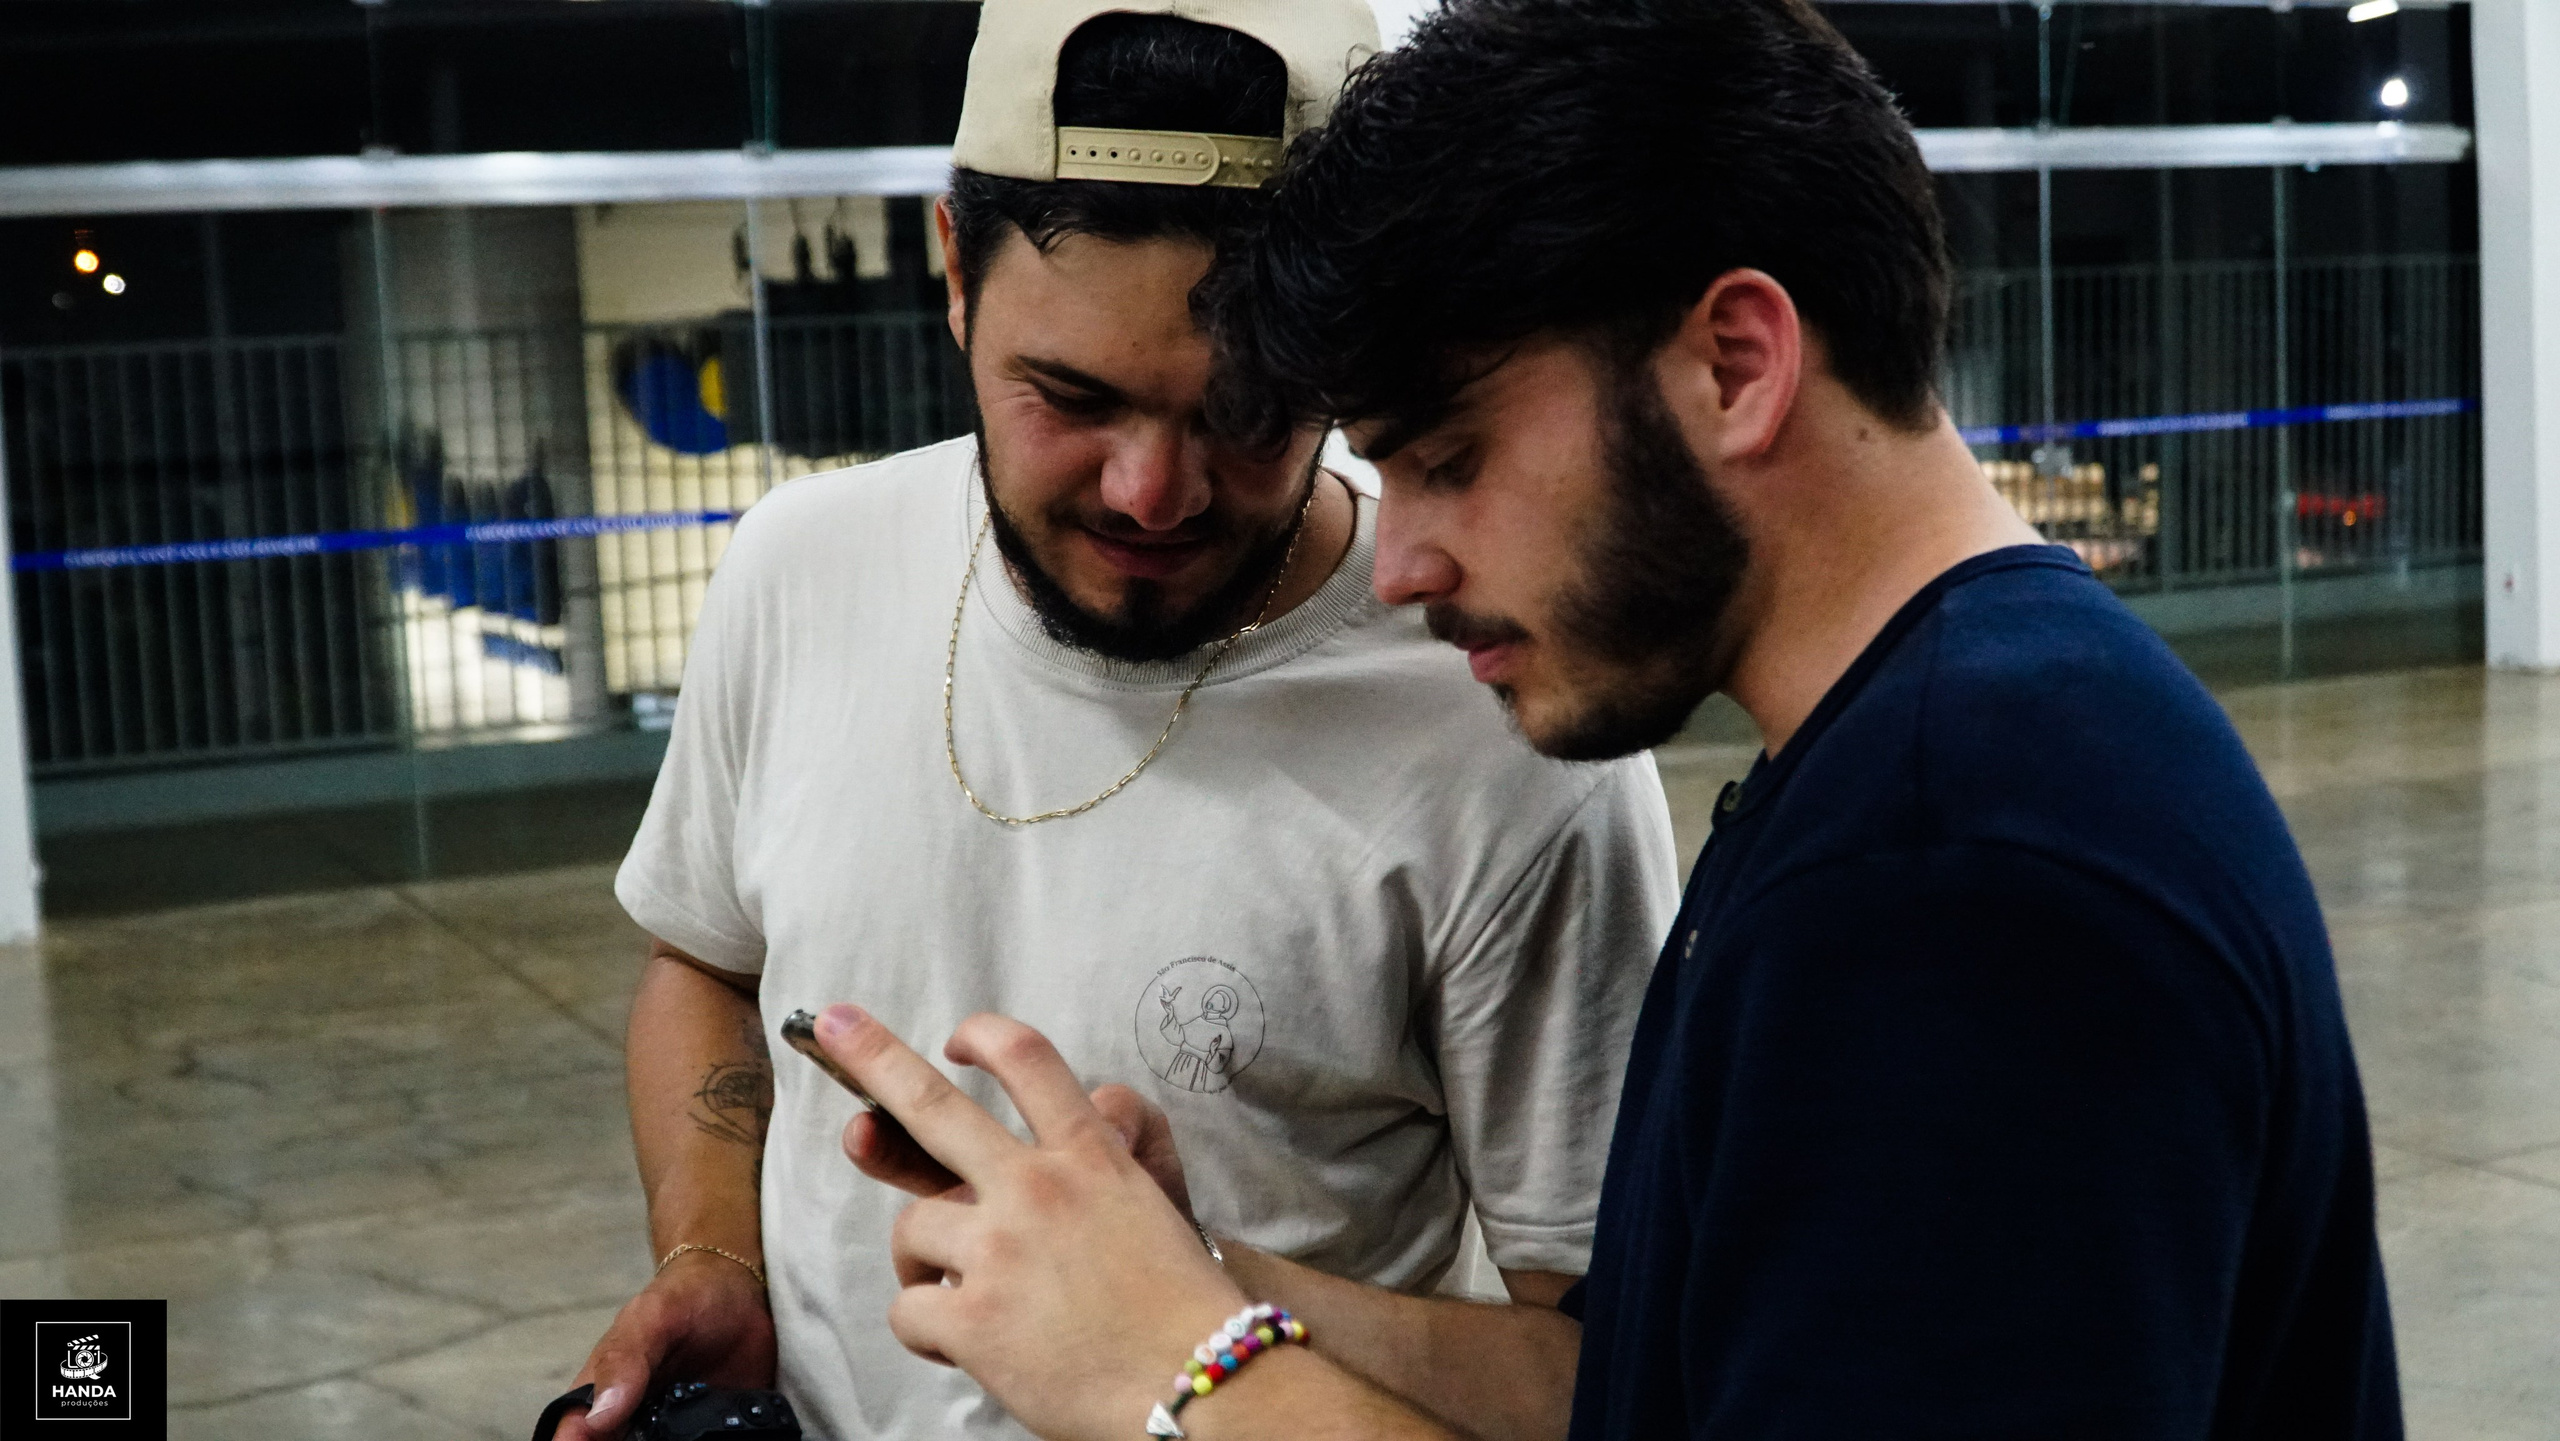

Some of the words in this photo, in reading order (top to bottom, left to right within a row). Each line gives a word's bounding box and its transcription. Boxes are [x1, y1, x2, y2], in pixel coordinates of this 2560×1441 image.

[1156, 965, 1170, 976] São
[1169, 956, 1206, 968] Francisco
[1207, 955, 1216, 963] de
